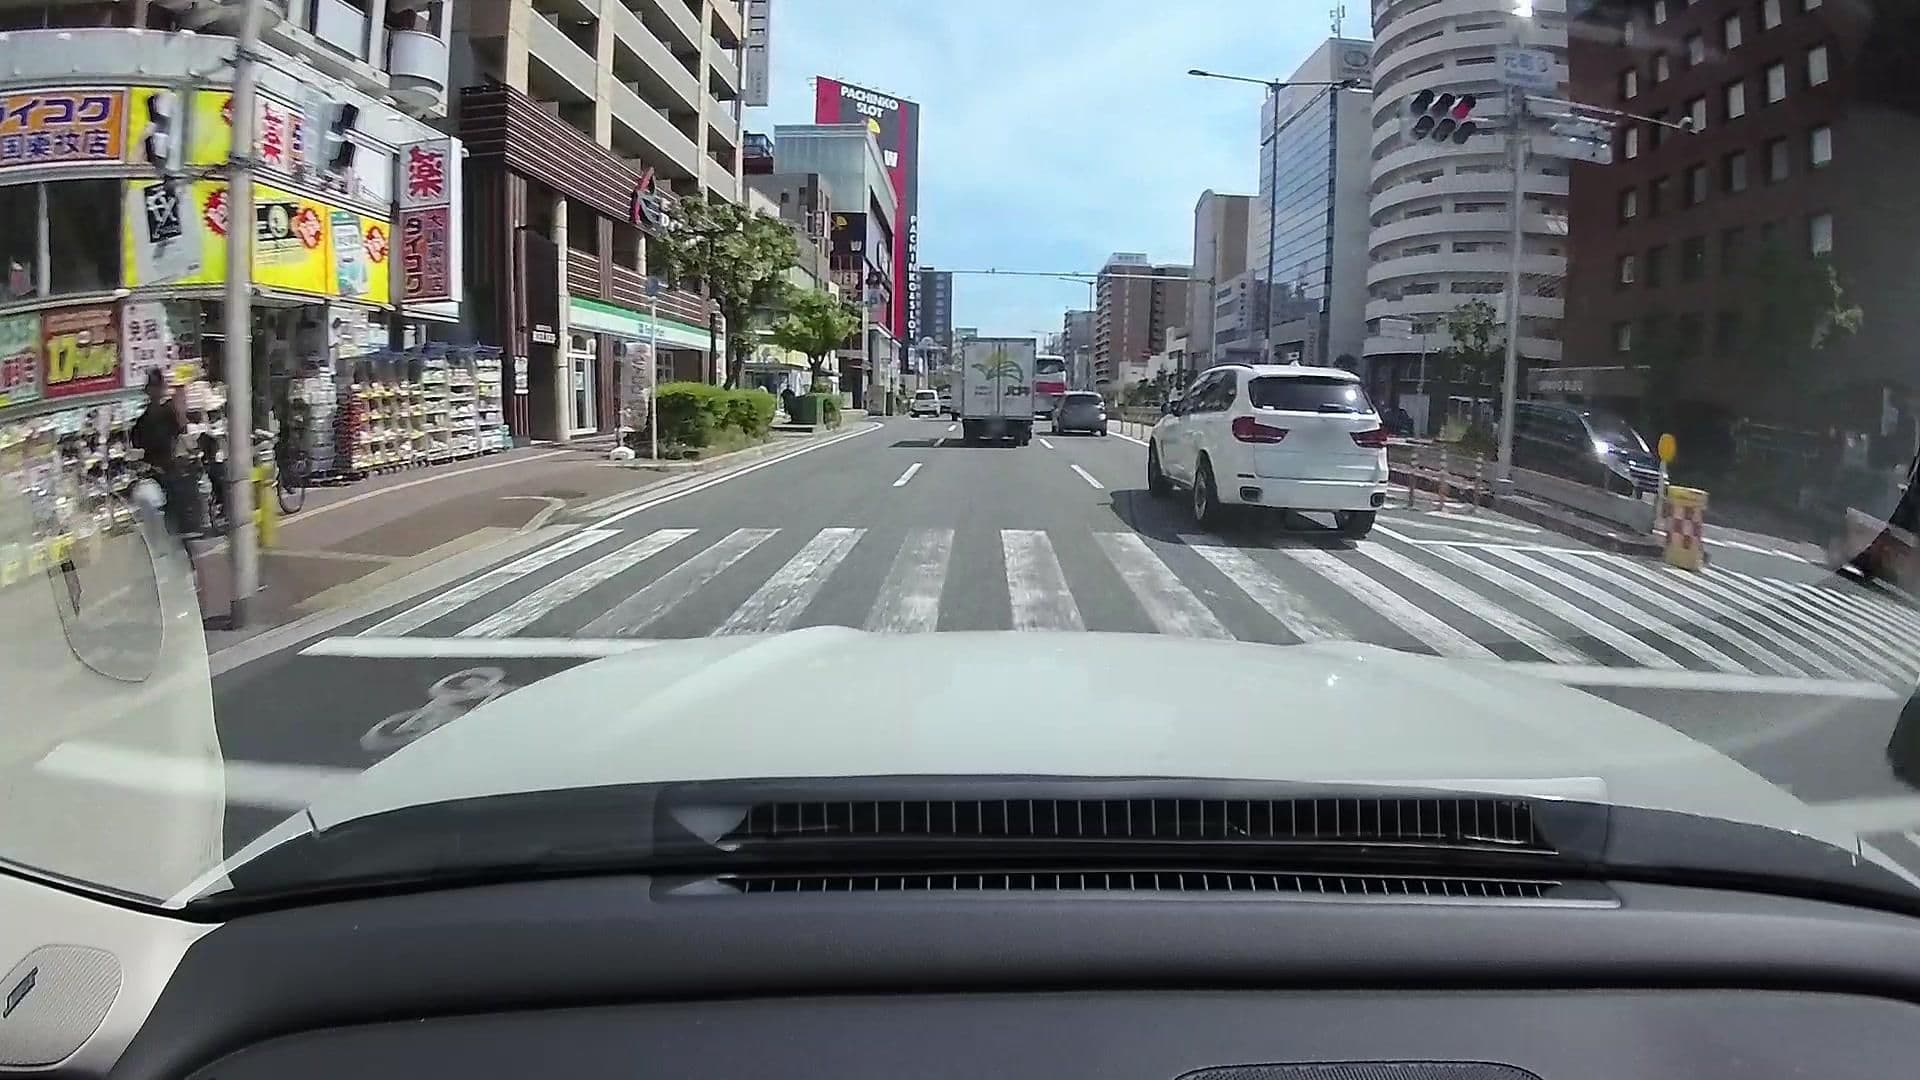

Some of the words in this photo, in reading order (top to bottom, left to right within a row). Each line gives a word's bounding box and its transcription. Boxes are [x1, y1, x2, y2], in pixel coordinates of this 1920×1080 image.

[0, 97, 111, 126] イコク
[840, 86, 898, 111] PACHINKO
[856, 102, 884, 118] SLOT
[408, 145, 444, 198] 薬
